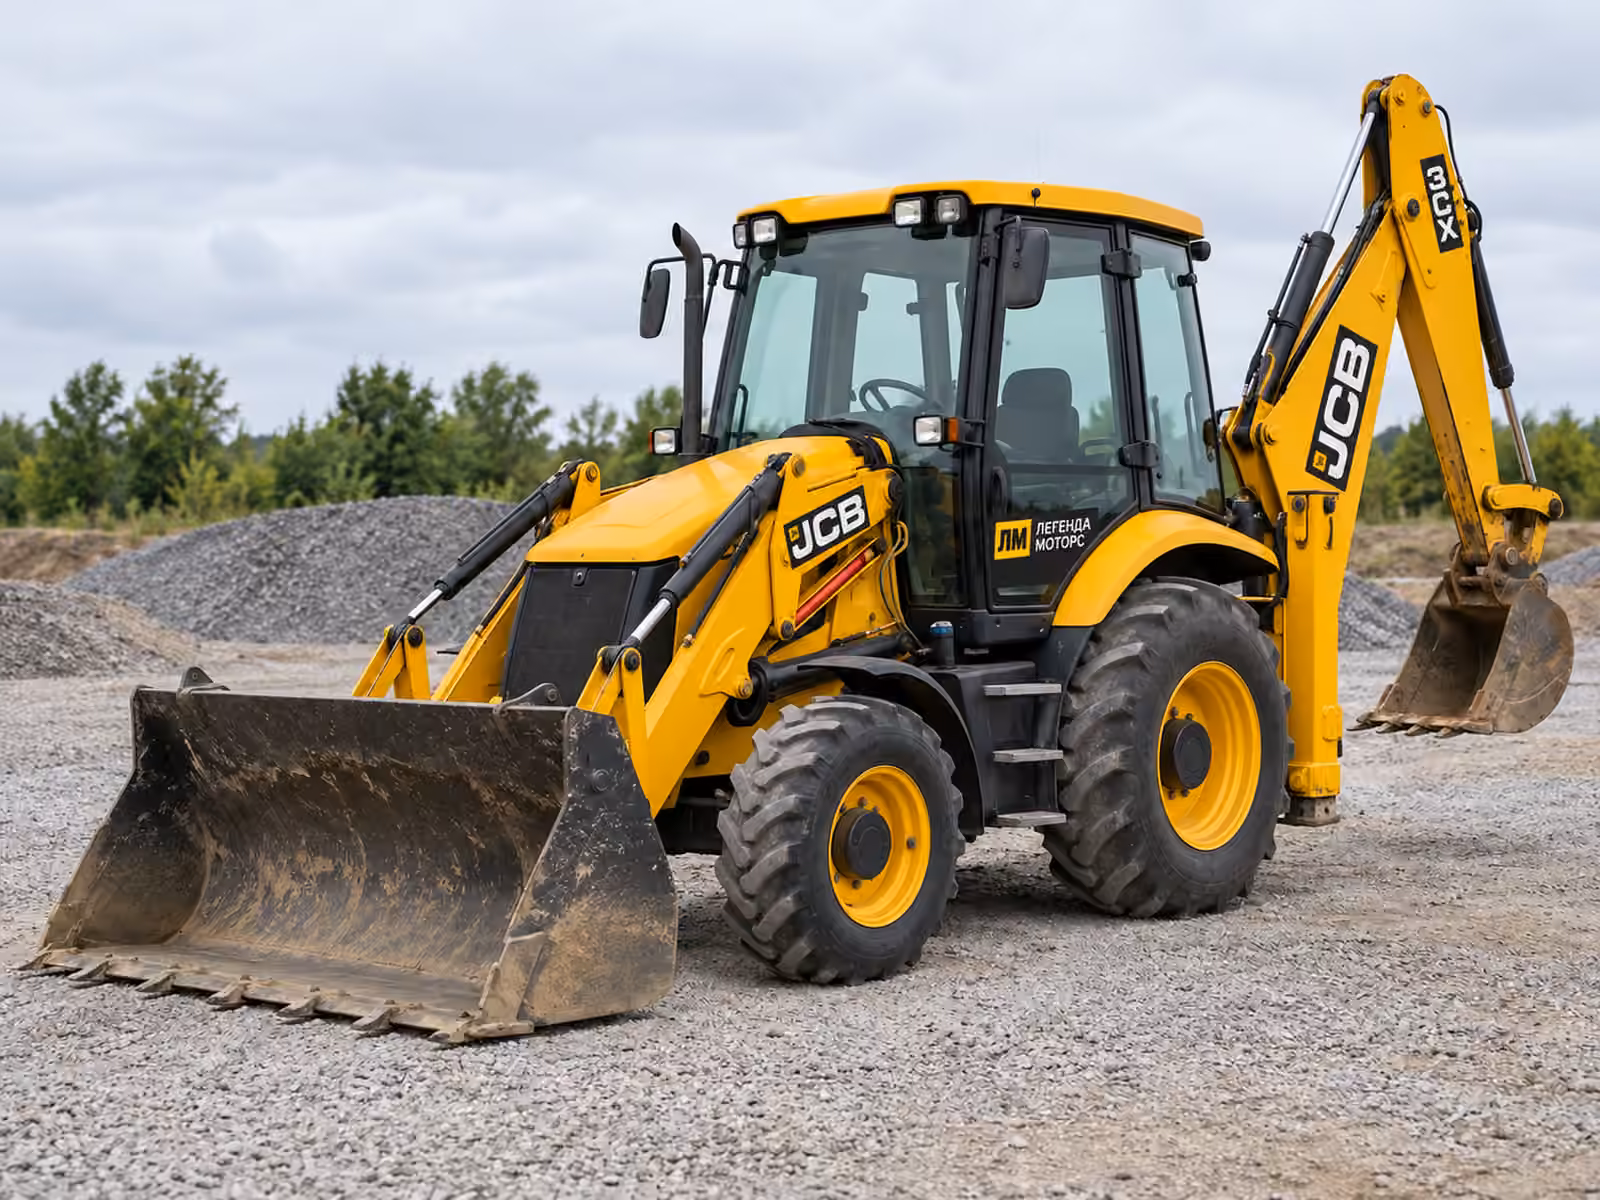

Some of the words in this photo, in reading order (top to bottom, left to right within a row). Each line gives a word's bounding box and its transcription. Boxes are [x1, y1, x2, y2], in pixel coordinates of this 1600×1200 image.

[1427, 165, 1459, 243] 3CX
[1318, 337, 1370, 480] JCB
[792, 494, 866, 560] JCB
[997, 526, 1027, 553] ЛМ
[1035, 517, 1092, 536] ЛЕГЕНДА
[1035, 534, 1085, 552] МОТОРС
